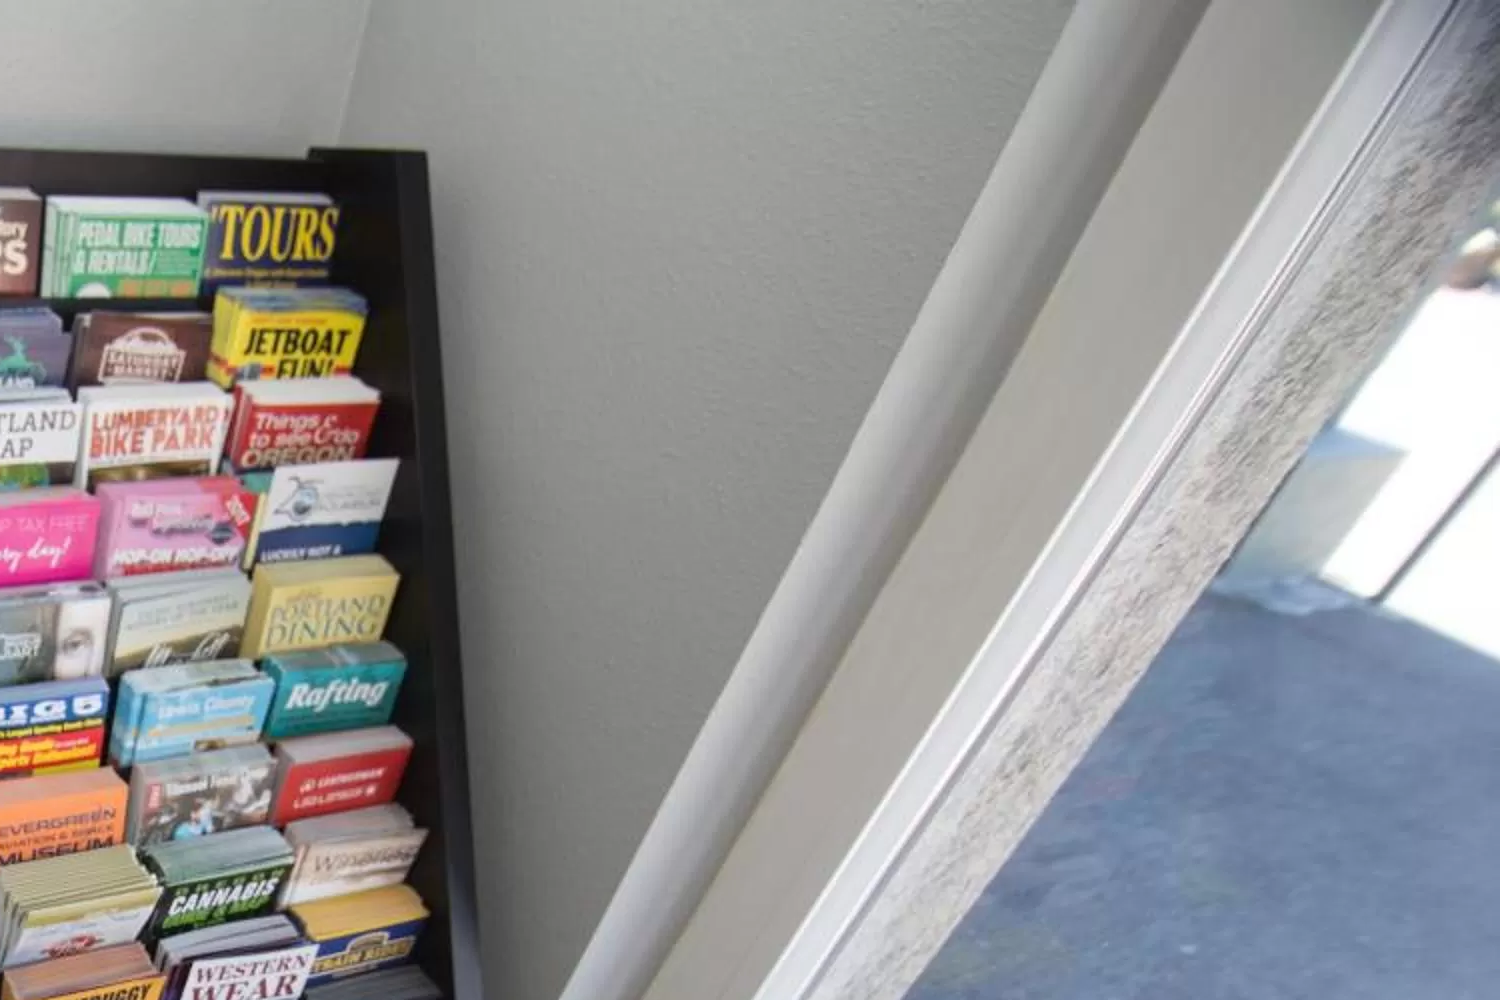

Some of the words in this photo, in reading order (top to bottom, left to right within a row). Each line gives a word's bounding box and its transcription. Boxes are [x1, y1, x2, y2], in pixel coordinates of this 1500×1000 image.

[216, 204, 340, 262] TOURS
[244, 328, 353, 357] JETBOAT
[90, 430, 145, 459] BIKE
[150, 424, 217, 452] PARK
[26, 535, 72, 569] day!
[271, 595, 386, 624] PORTLAND
[265, 617, 377, 648] DINING
[285, 679, 389, 713] Rafting
[168, 876, 280, 916] CANNABIS
[195, 951, 310, 984] WESTERN
